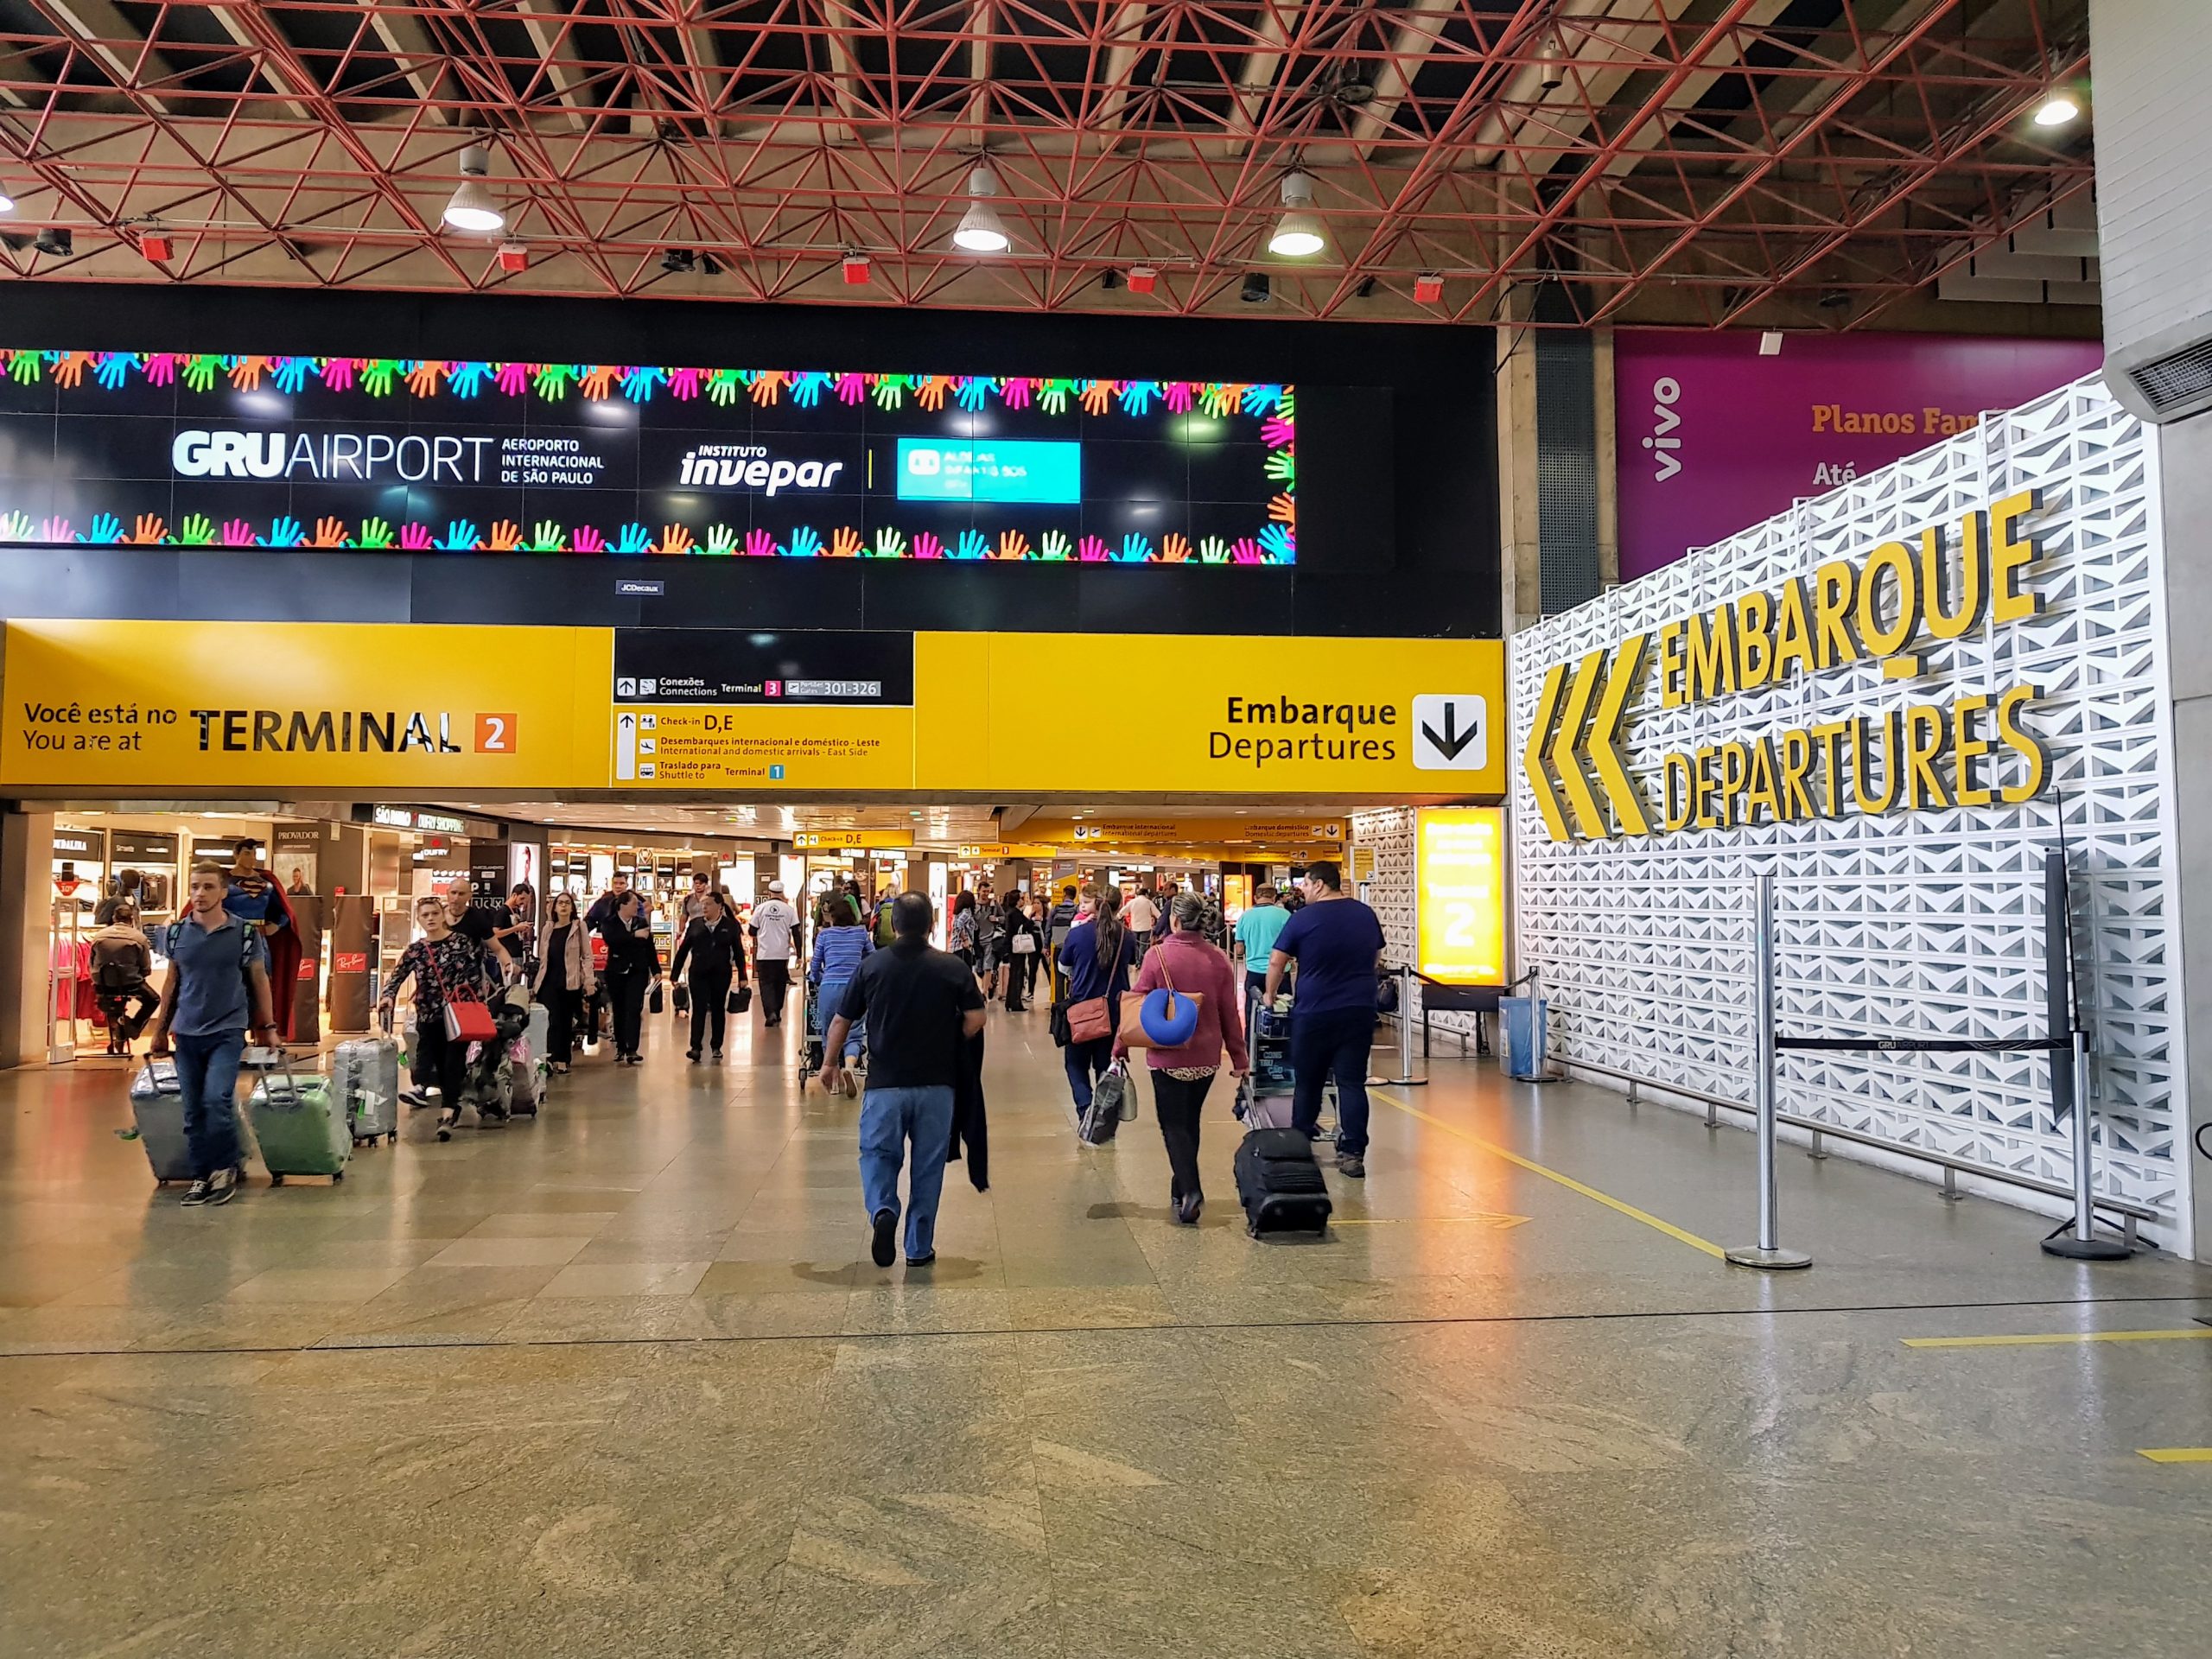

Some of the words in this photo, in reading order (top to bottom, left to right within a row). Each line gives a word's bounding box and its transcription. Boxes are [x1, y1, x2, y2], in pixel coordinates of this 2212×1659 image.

[1812, 404, 1916, 434] Planos
[1642, 376, 1683, 483] vivo
[502, 438, 579, 453] AEROPORTO
[698, 445, 766, 458] INSTITUTO
[501, 454, 605, 470] INTERNACIONAL
[501, 470, 518, 483] DE
[523, 467, 547, 484] SÃO
[552, 471, 594, 485] PAULO
[680, 452, 843, 497] invepar
[1813, 461, 1857, 486] Até
[1662, 489, 2046, 709] EMBARQUE
[659, 677, 704, 686] Conexões
[721, 683, 761, 693] Terminal
[769, 683, 777, 695] 3
[824, 683, 876, 695] 301-326
[659, 687, 717, 696] Connections
[24, 702, 81, 723] Você
[88, 702, 138, 724] está
[147, 709, 177, 724] no
[1227, 696, 1396, 733] Embarque
[190, 709, 461, 753] TERMINAL
[484, 718, 505, 750] 2
[705, 715, 733, 734] D,E
[23, 729, 66, 750] You
[73, 734, 111, 751] are
[118, 731, 142, 751] at
[661, 737, 729, 747] Desembarques
[731, 737, 792, 746] internacional
[660, 747, 721, 755] International
[723, 747, 741, 755] and
[743, 747, 785, 756] domestic
[786, 747, 820, 756] arrivals
[1210, 731, 1395, 768] Departures
[1664, 683, 2053, 832] DEPARTURES
[659, 761, 698, 770] Traslado
[773, 766, 781, 779] 1
[278, 831, 319, 840] PROVADOR
[846, 834, 861, 845] D,E
[1444, 902, 1475, 947] 2
